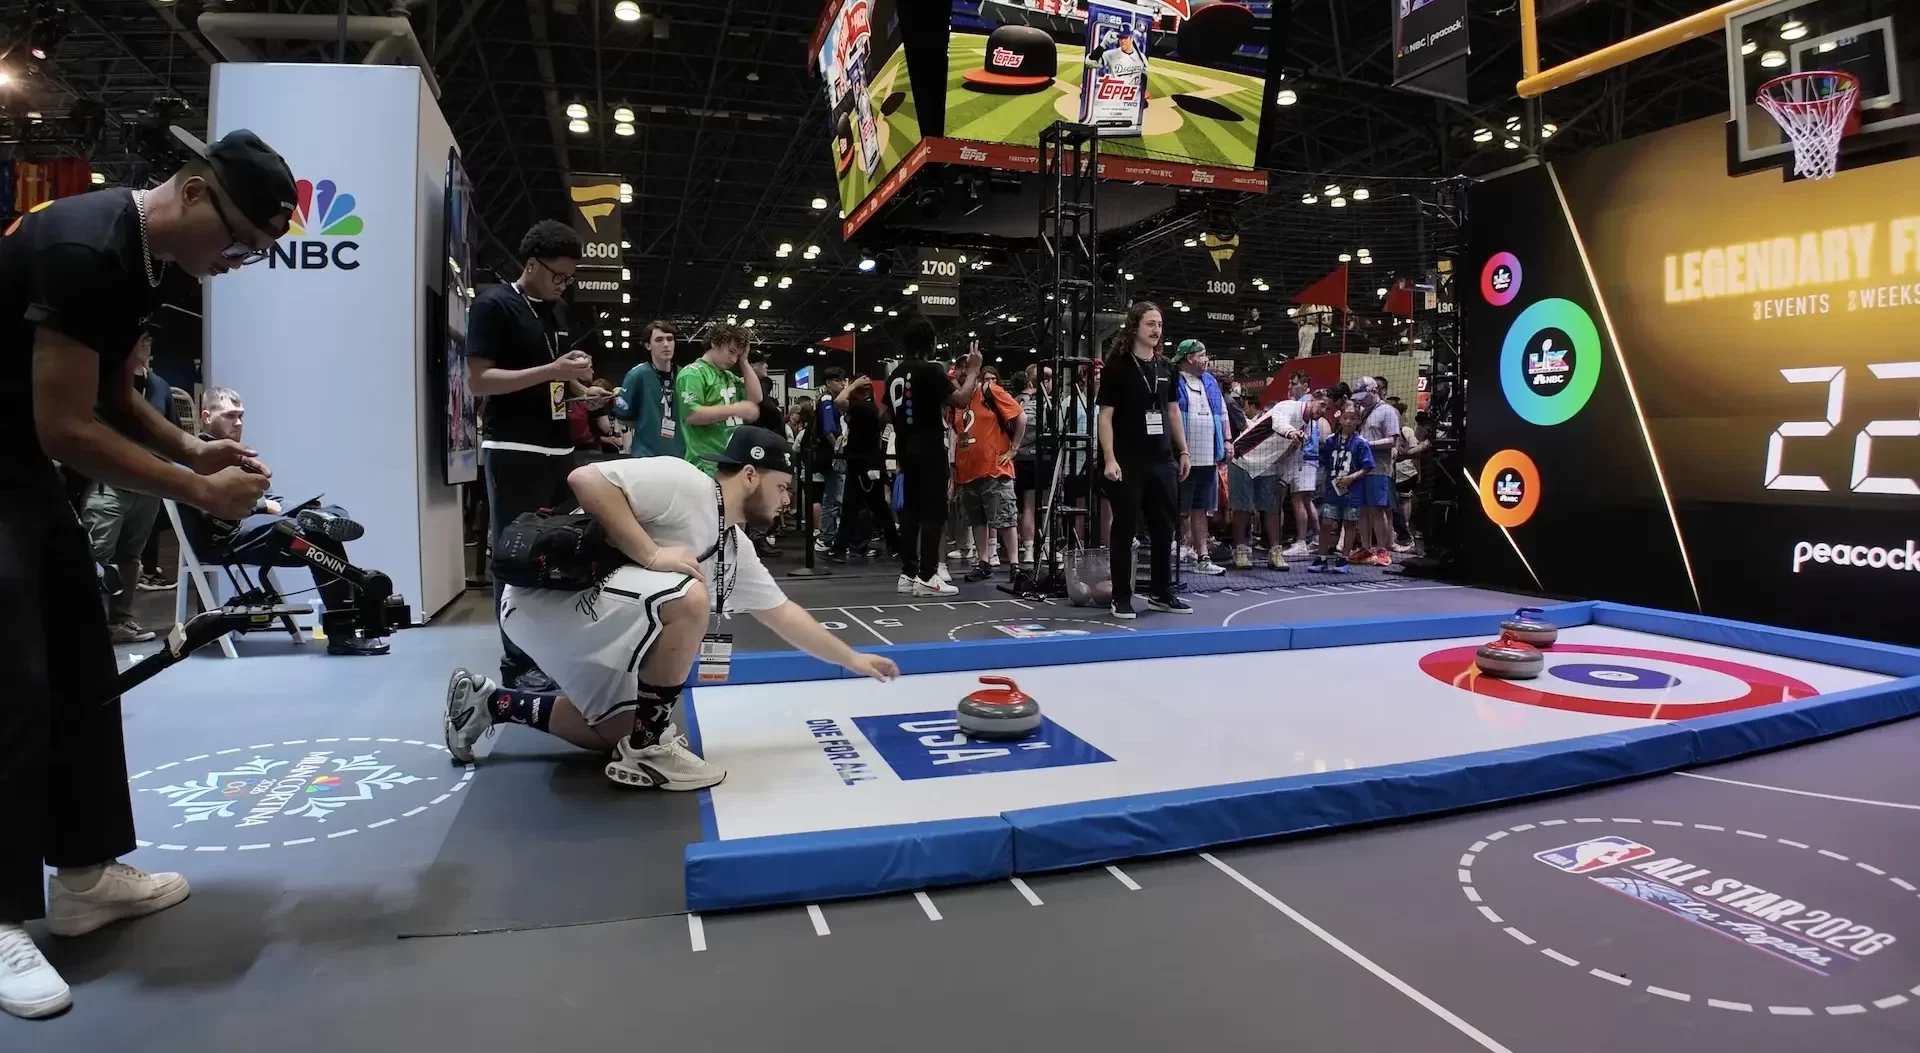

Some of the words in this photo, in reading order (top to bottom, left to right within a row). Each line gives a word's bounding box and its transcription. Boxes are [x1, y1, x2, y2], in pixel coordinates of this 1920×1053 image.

[1409, 38, 1426, 53] NBC
[1430, 20, 1462, 46] peacock
[1160, 169, 1173, 178] NYC
[269, 240, 360, 271] NBC
[1664, 222, 1877, 304] LEGENDARY
[921, 259, 956, 276] 1700
[577, 279, 619, 291] venmo
[1206, 280, 1236, 295] 1800
[921, 295, 956, 306] venmo
[1207, 312, 1235, 322] venmo
[1545, 374, 1564, 384] NBC
[306, 546, 346, 574] RONIN
[1792, 539, 1920, 573] peacock
[805, 718, 839, 738] ONE
[818, 739, 861, 761] FOR
[898, 718, 1012, 766] USA
[833, 762, 878, 786] ALL
[1630, 857, 1711, 887] ALL
[1693, 878, 1806, 922] STAR
[1782, 909, 1896, 956] 2026
[1668, 900, 1718, 922] Los
[1717, 919, 1832, 967] Angeles
